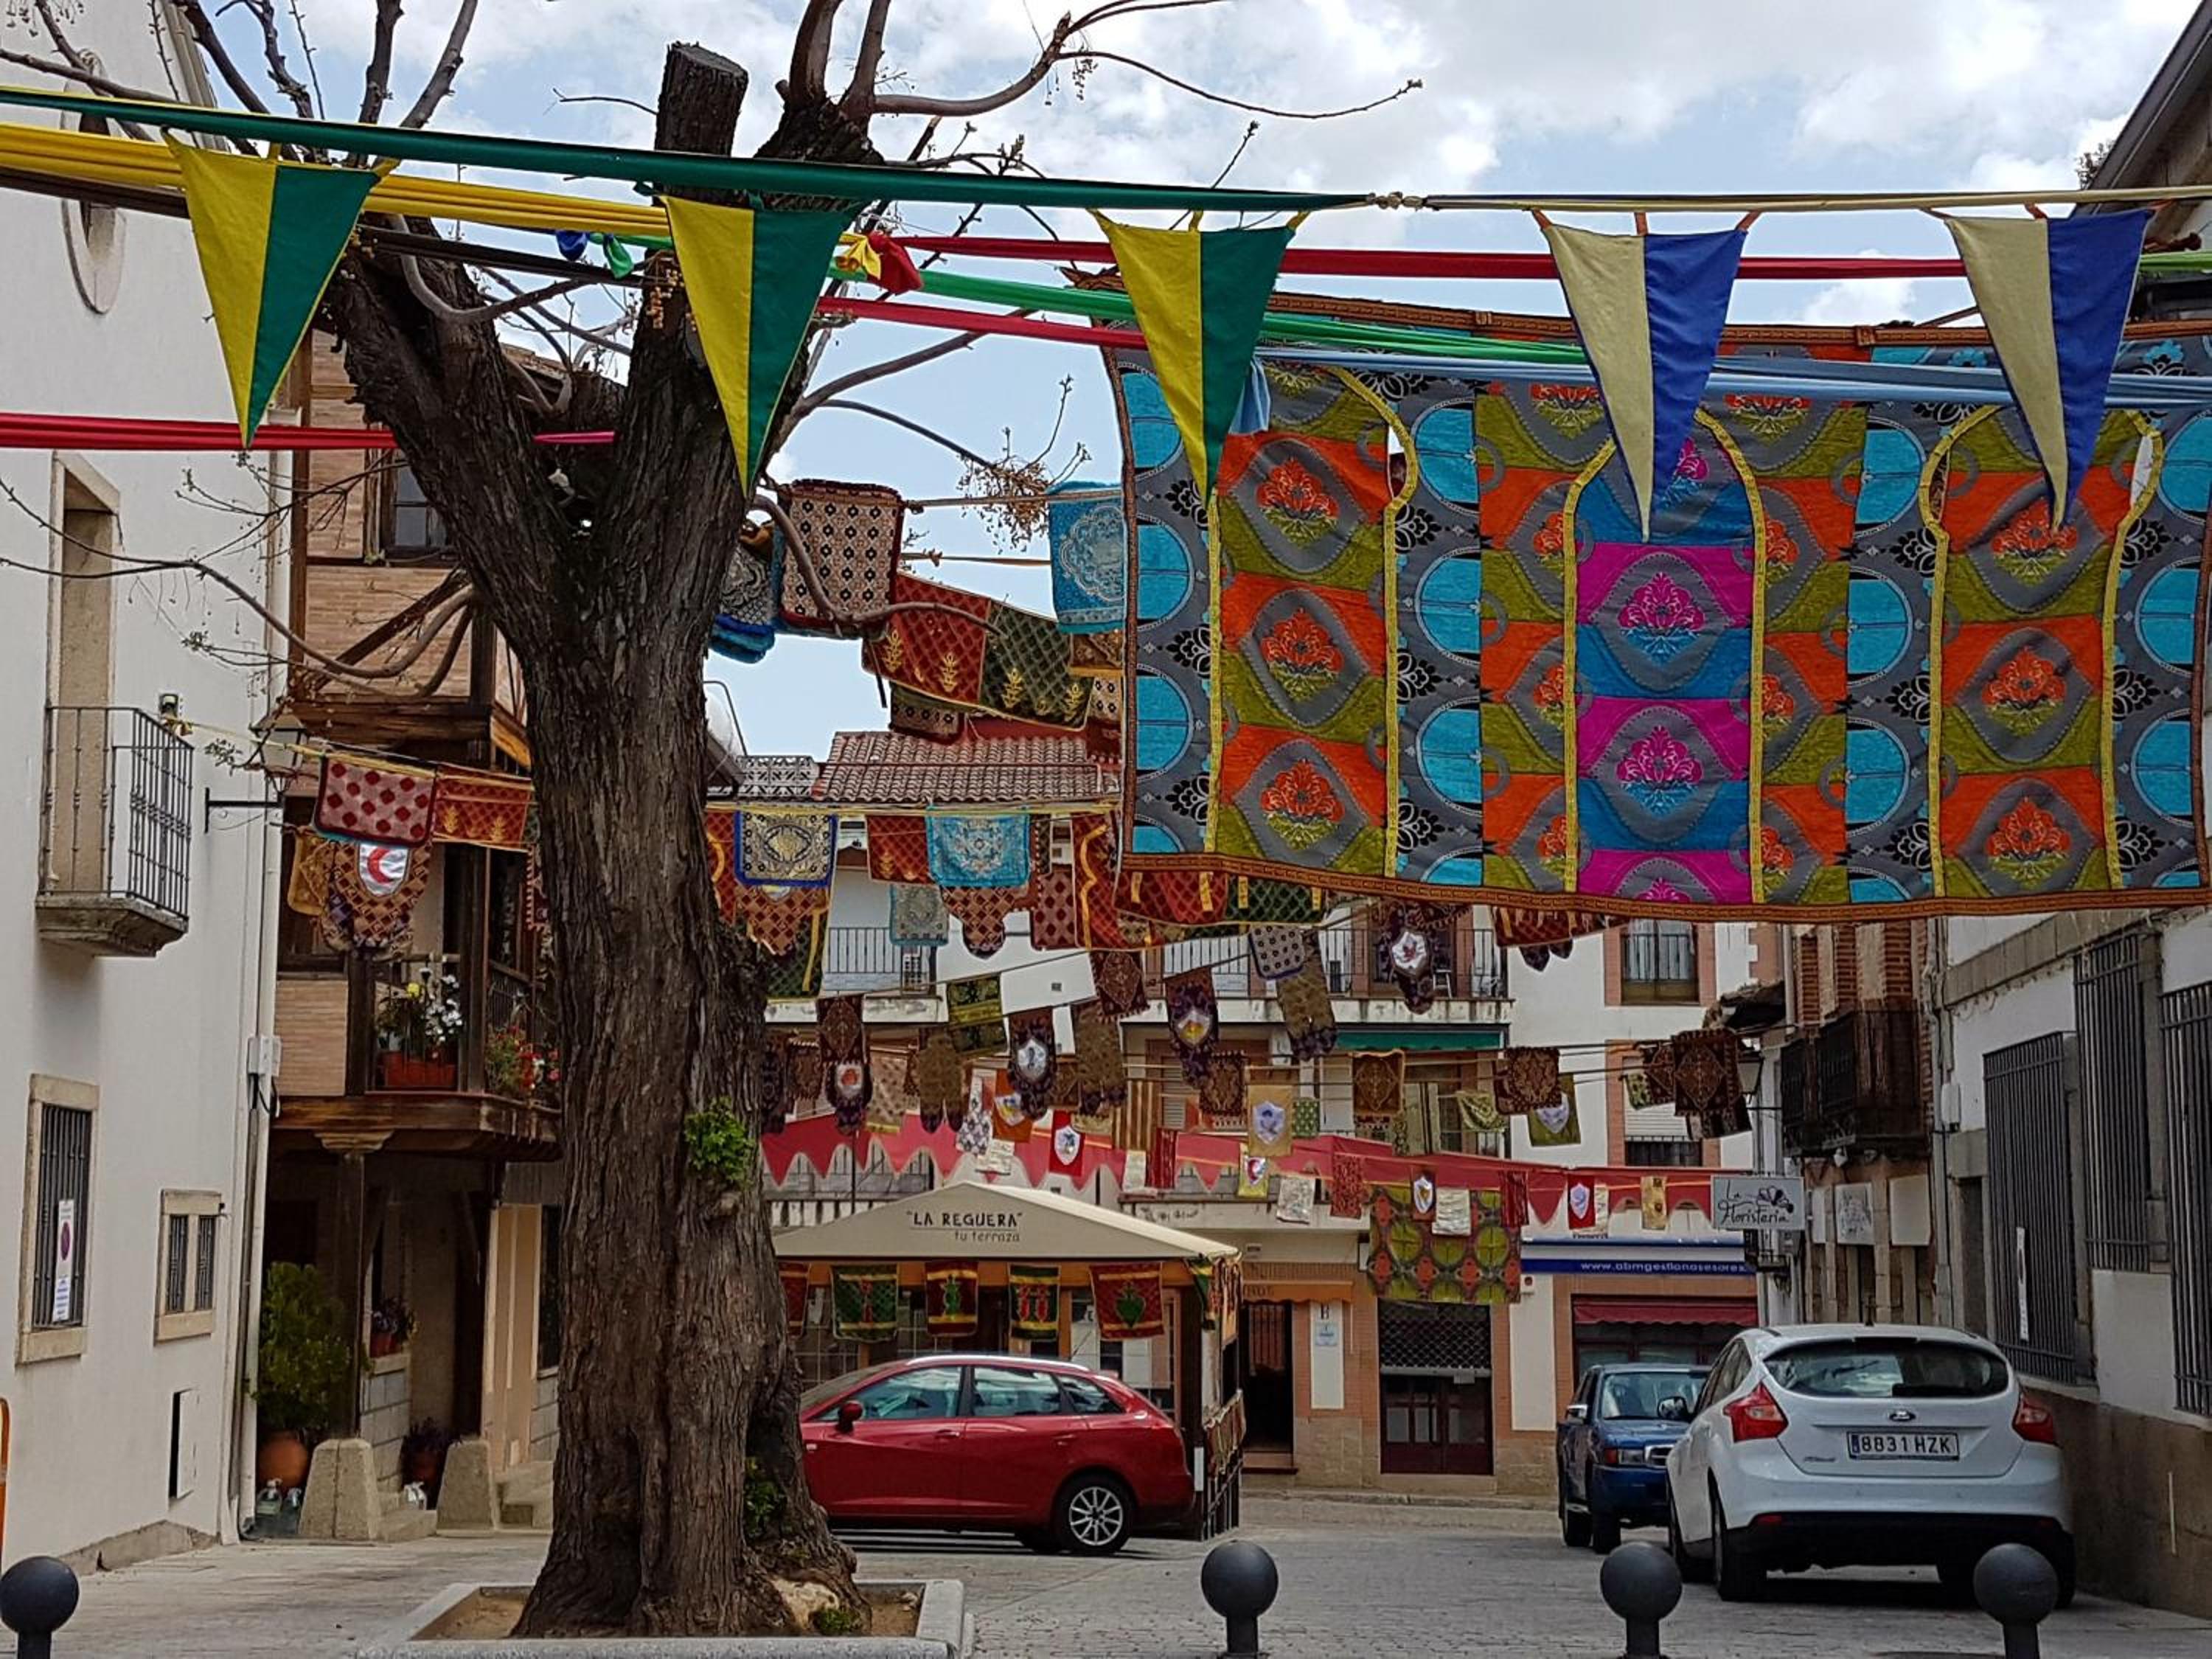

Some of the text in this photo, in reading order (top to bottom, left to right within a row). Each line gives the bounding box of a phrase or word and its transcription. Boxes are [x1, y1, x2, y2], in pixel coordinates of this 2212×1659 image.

[955, 1231, 1020, 1242] tu terraza
[1861, 1436, 1951, 1454] 8831 HZK
